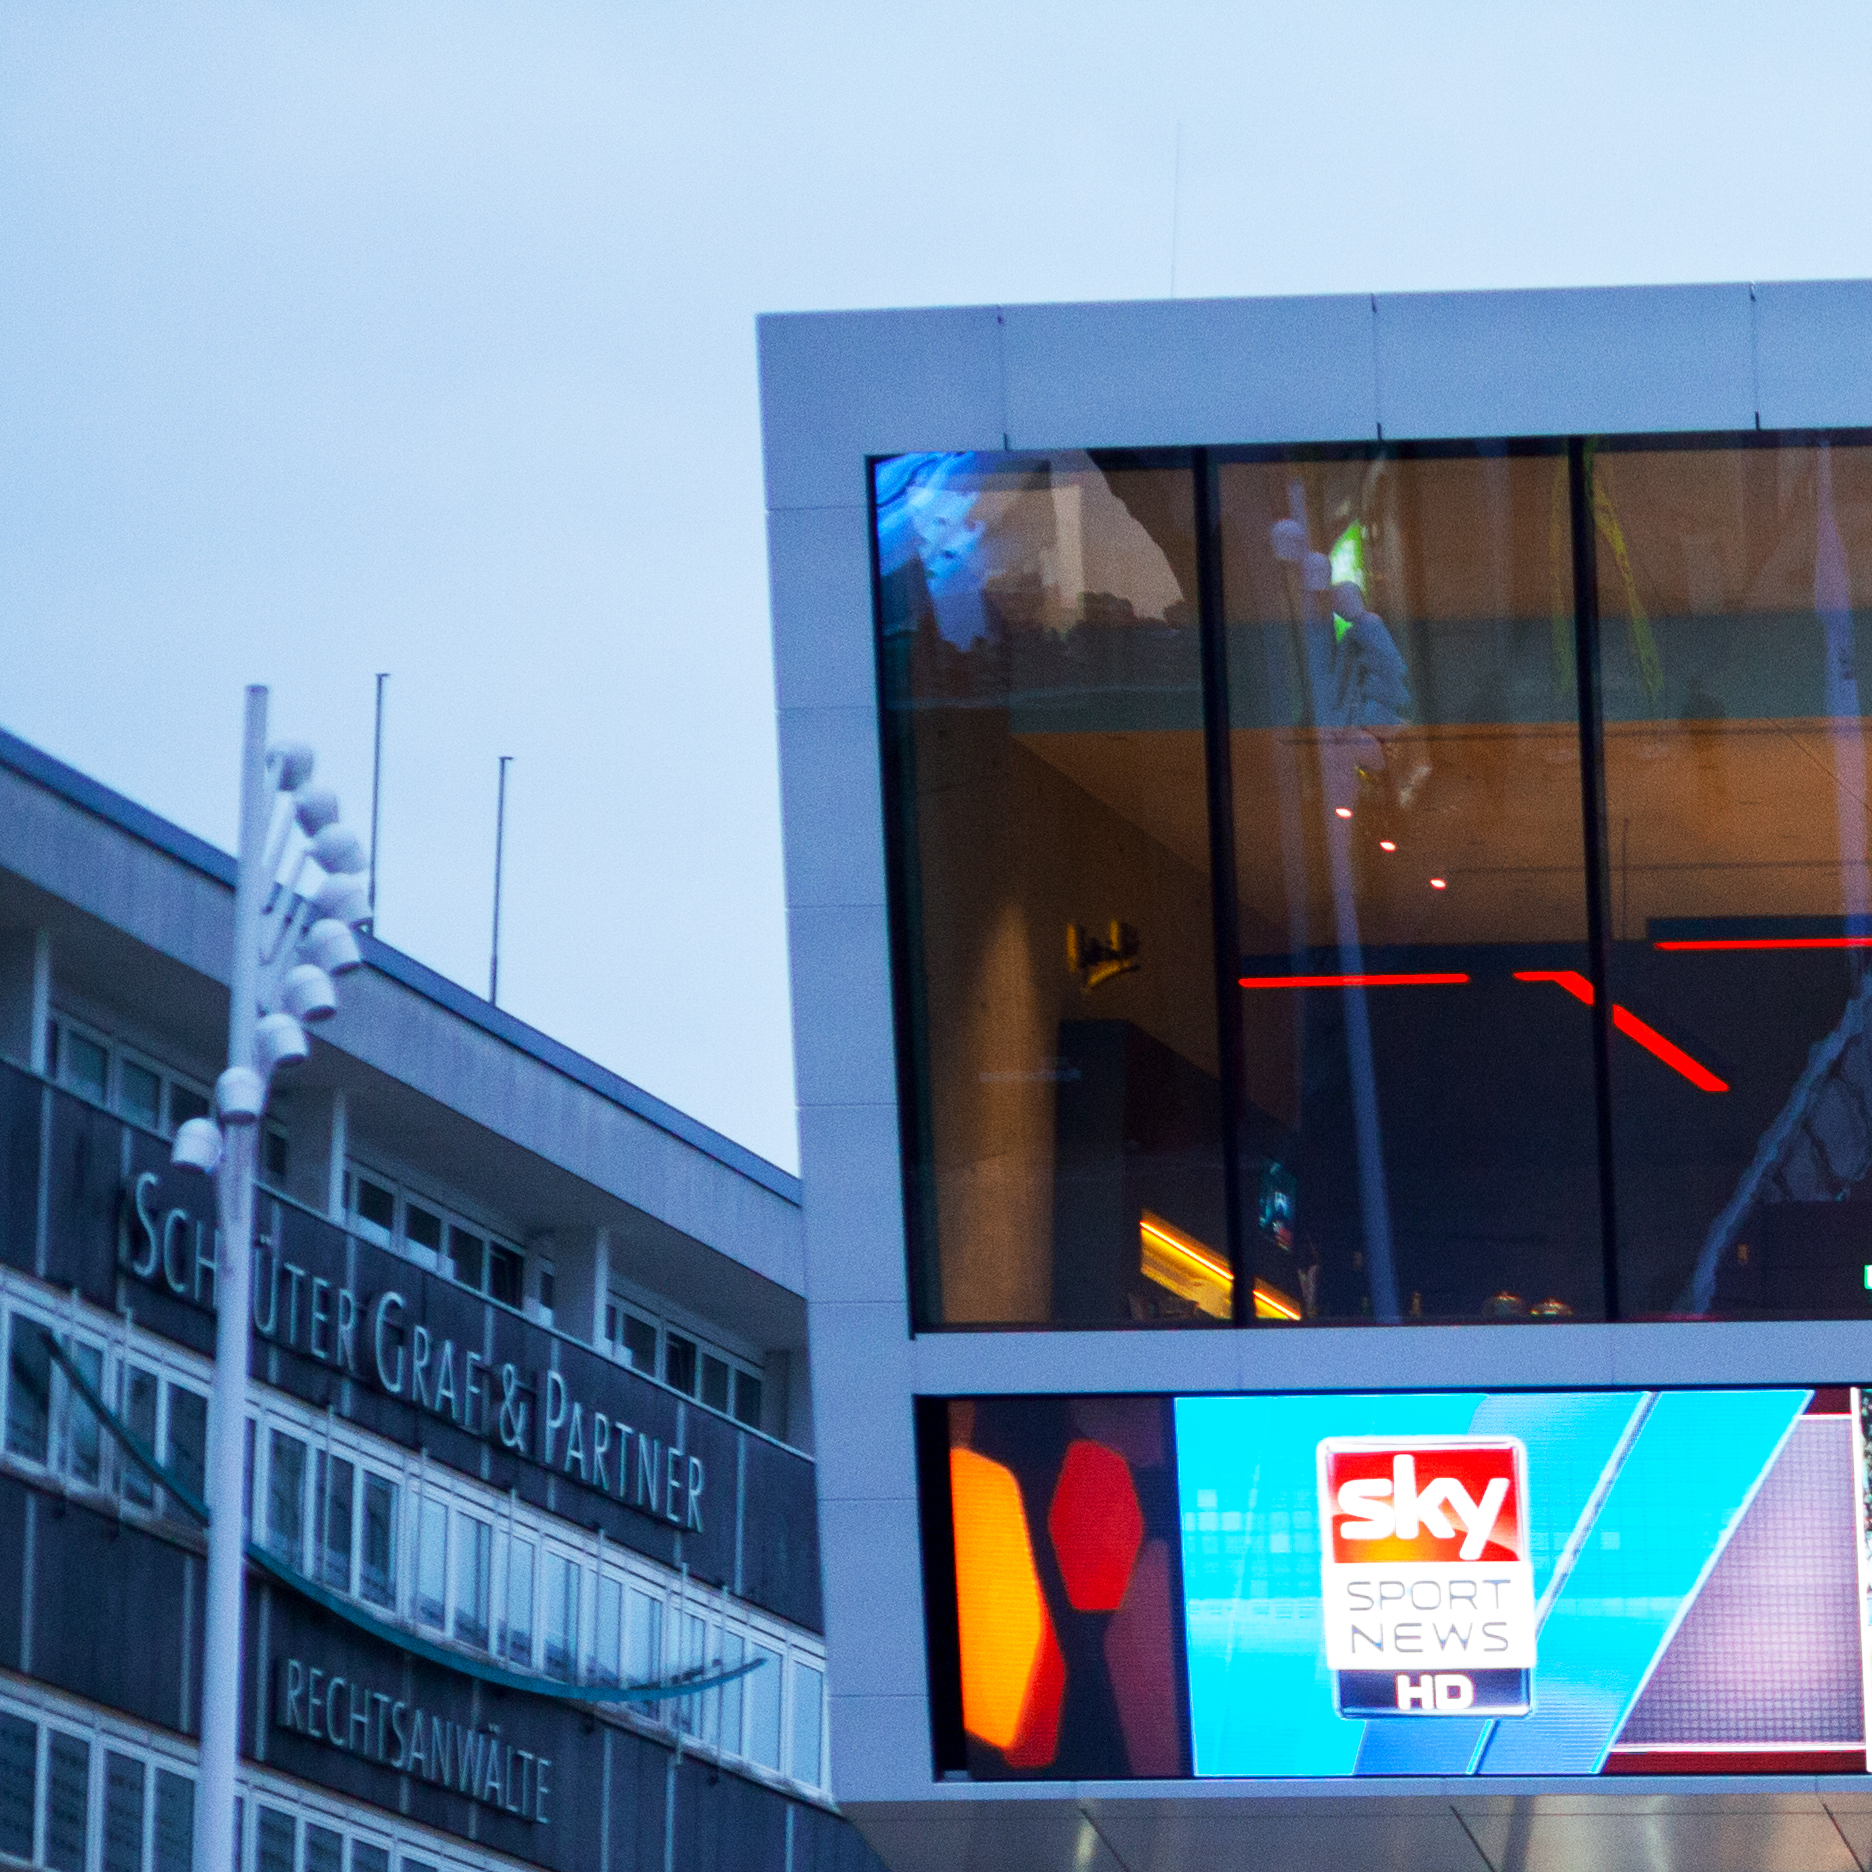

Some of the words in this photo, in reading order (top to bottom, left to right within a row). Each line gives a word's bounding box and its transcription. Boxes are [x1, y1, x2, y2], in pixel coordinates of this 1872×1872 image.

[133, 1172, 355, 1371] SCHÜTER
[375, 1291, 482, 1427] GRAF
[500, 1363, 526, 1451] &
[546, 1370, 702, 1533] PARTNER
[1337, 1453, 1510, 1561] sky
[1347, 1579, 1512, 1611] SPORT
[1350, 1621, 1509, 1653] NEWS
[1395, 1672, 1475, 1711] HD
[286, 1658, 551, 1825] RECHTSANWÄLTE
